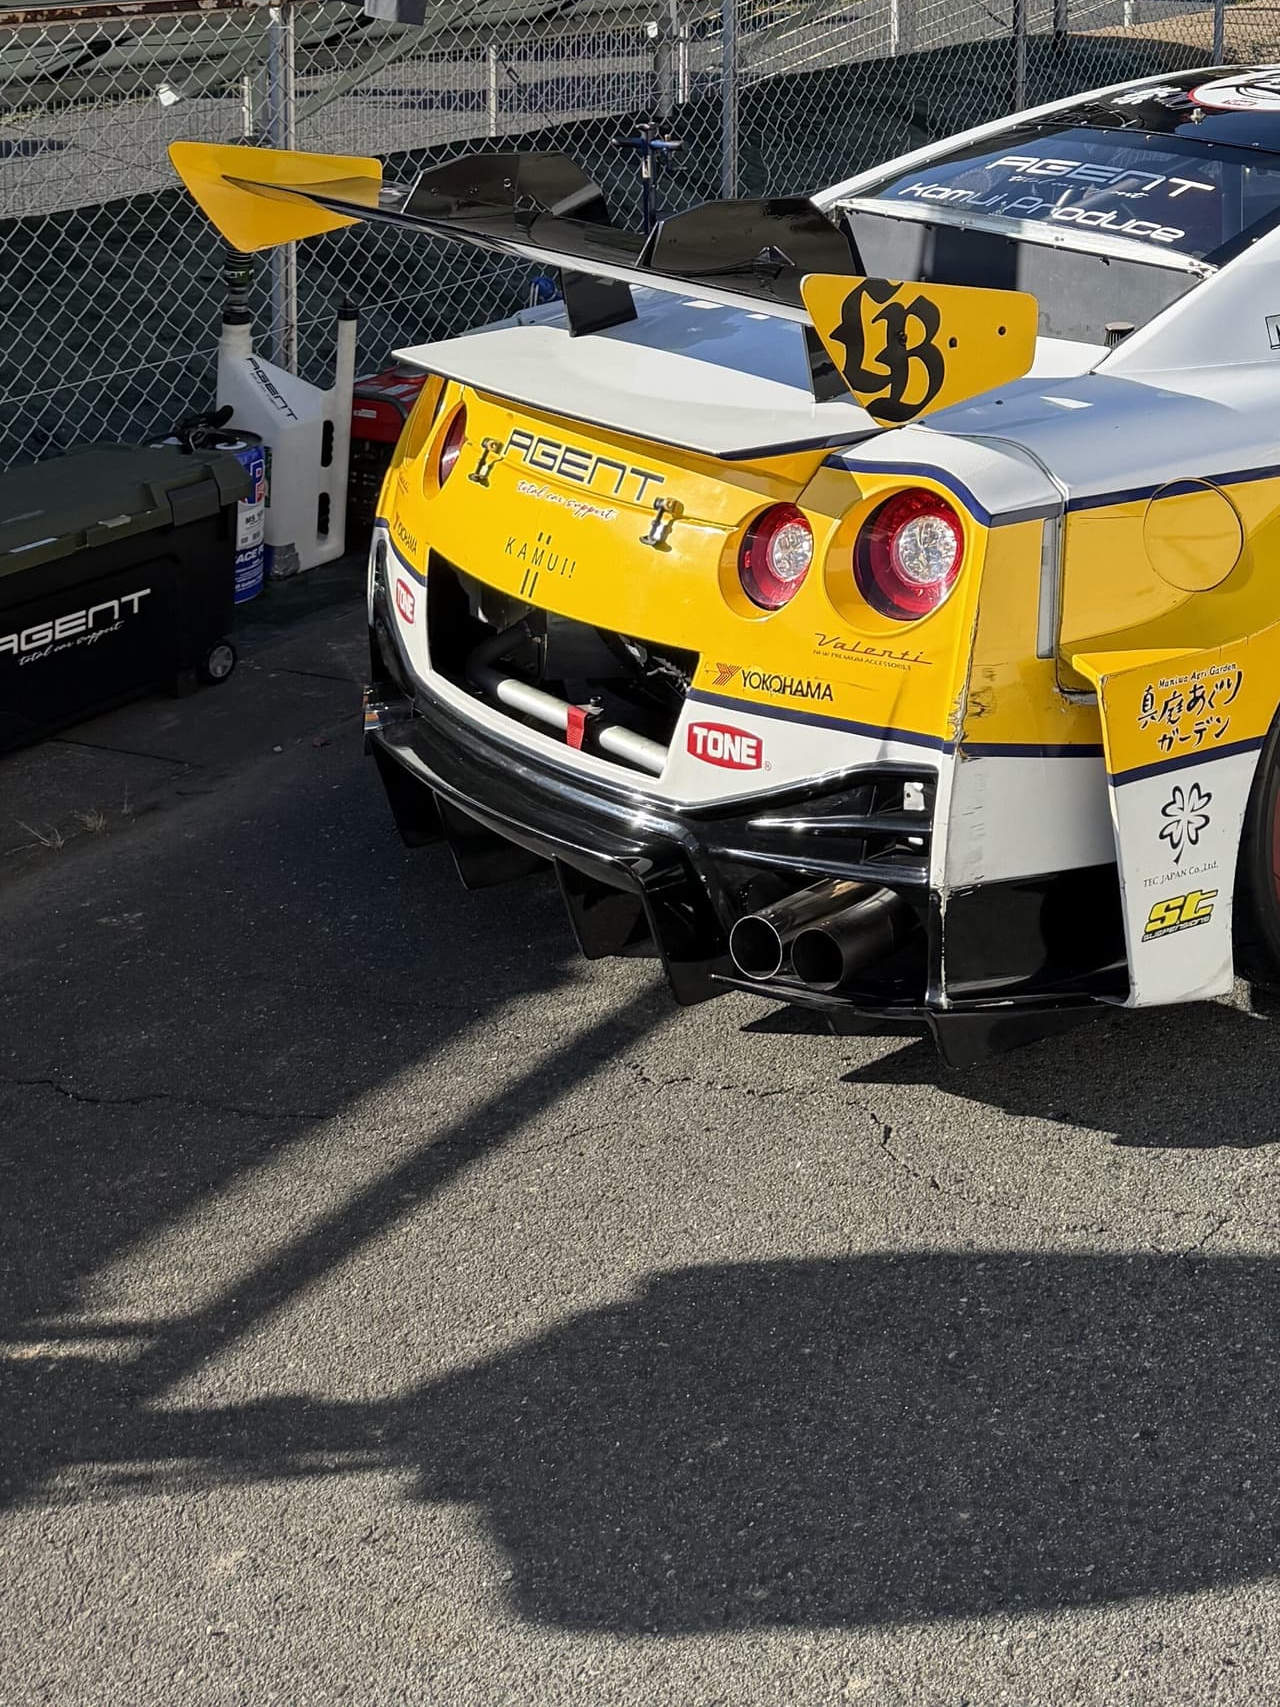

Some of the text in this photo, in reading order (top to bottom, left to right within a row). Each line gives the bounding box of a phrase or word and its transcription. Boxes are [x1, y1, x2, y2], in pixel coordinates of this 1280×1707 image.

[984, 155, 1216, 197] AGENT
[245, 356, 299, 421] AGENT
[502, 428, 667, 502] AGENT
[0, 588, 151, 655] AGENT
[815, 632, 933, 665] Valenti
[742, 669, 834, 701] YOKOHAMA
[1209, 663, 1237, 675] Garden
[1137, 671, 1242, 729] 真庭あぐり
[694, 727, 757, 766] TONE
[1157, 717, 1230, 751] ガーデン
[1144, 876, 1158, 887] TEC
[1160, 868, 1186, 885] JAPAN
